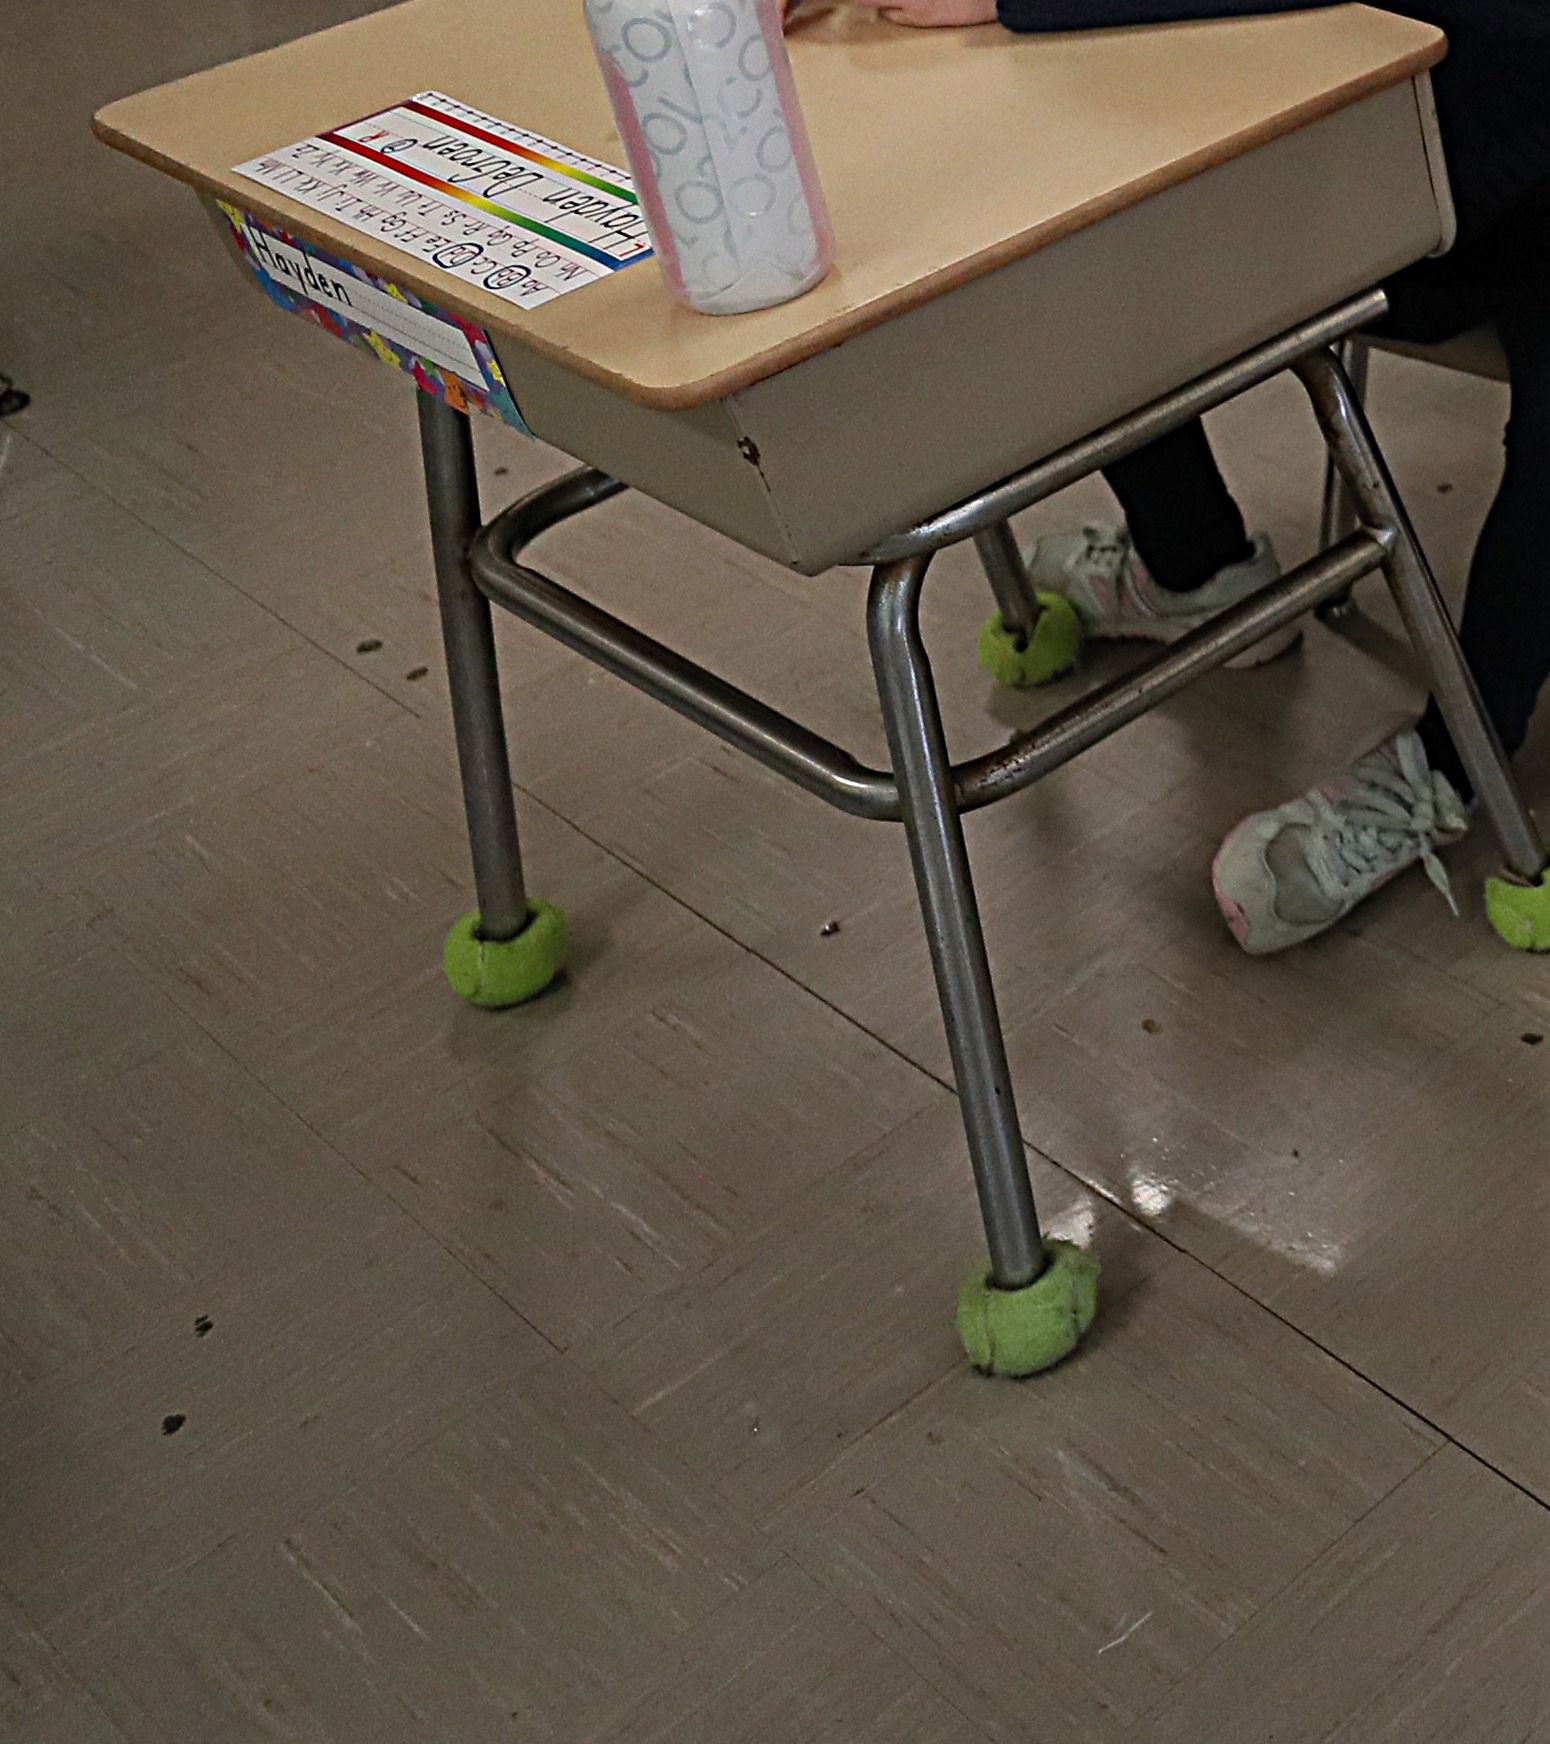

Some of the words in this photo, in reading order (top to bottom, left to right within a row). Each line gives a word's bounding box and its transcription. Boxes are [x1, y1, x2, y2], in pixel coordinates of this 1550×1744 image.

[358, 130, 389, 142] R
[422, 134, 544, 199] DeGroen
[294, 177, 328, 194] Kk
[354, 205, 385, 221] Hh
[441, 210, 467, 225] Ss
[544, 187, 652, 250] Hayden
[381, 212, 407, 232] Gg
[463, 221, 490, 235] Rr
[394, 227, 429, 242] Ff
[487, 226, 515, 246] Qq
[422, 236, 452, 252] Ee
[511, 239, 538, 257] Pp
[247, 221, 352, 309] Hayden
[535, 251, 561, 268] Oo
[556, 262, 589, 281] Nn
[520, 279, 550, 296] Aa
